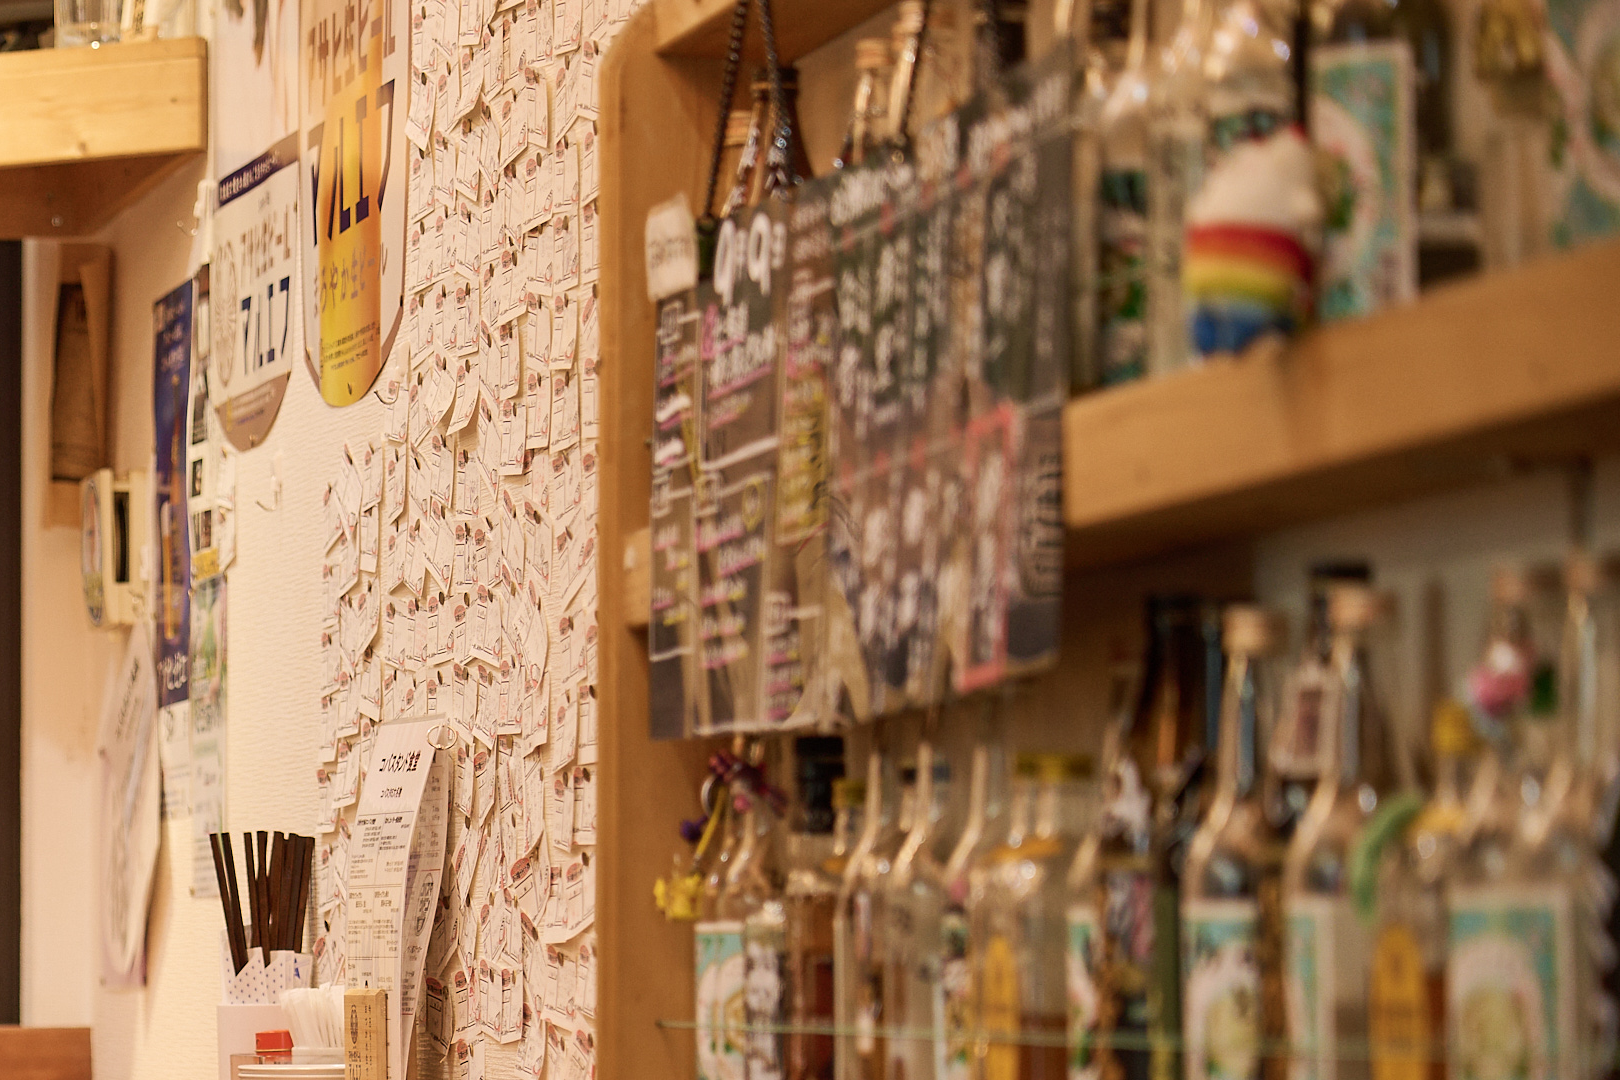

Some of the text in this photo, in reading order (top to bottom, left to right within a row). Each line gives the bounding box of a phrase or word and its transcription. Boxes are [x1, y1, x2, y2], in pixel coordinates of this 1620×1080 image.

[306, 78, 396, 249] マルエフ
[241, 275, 290, 376] マルエフ
[313, 241, 389, 318] まろやか生ビール
